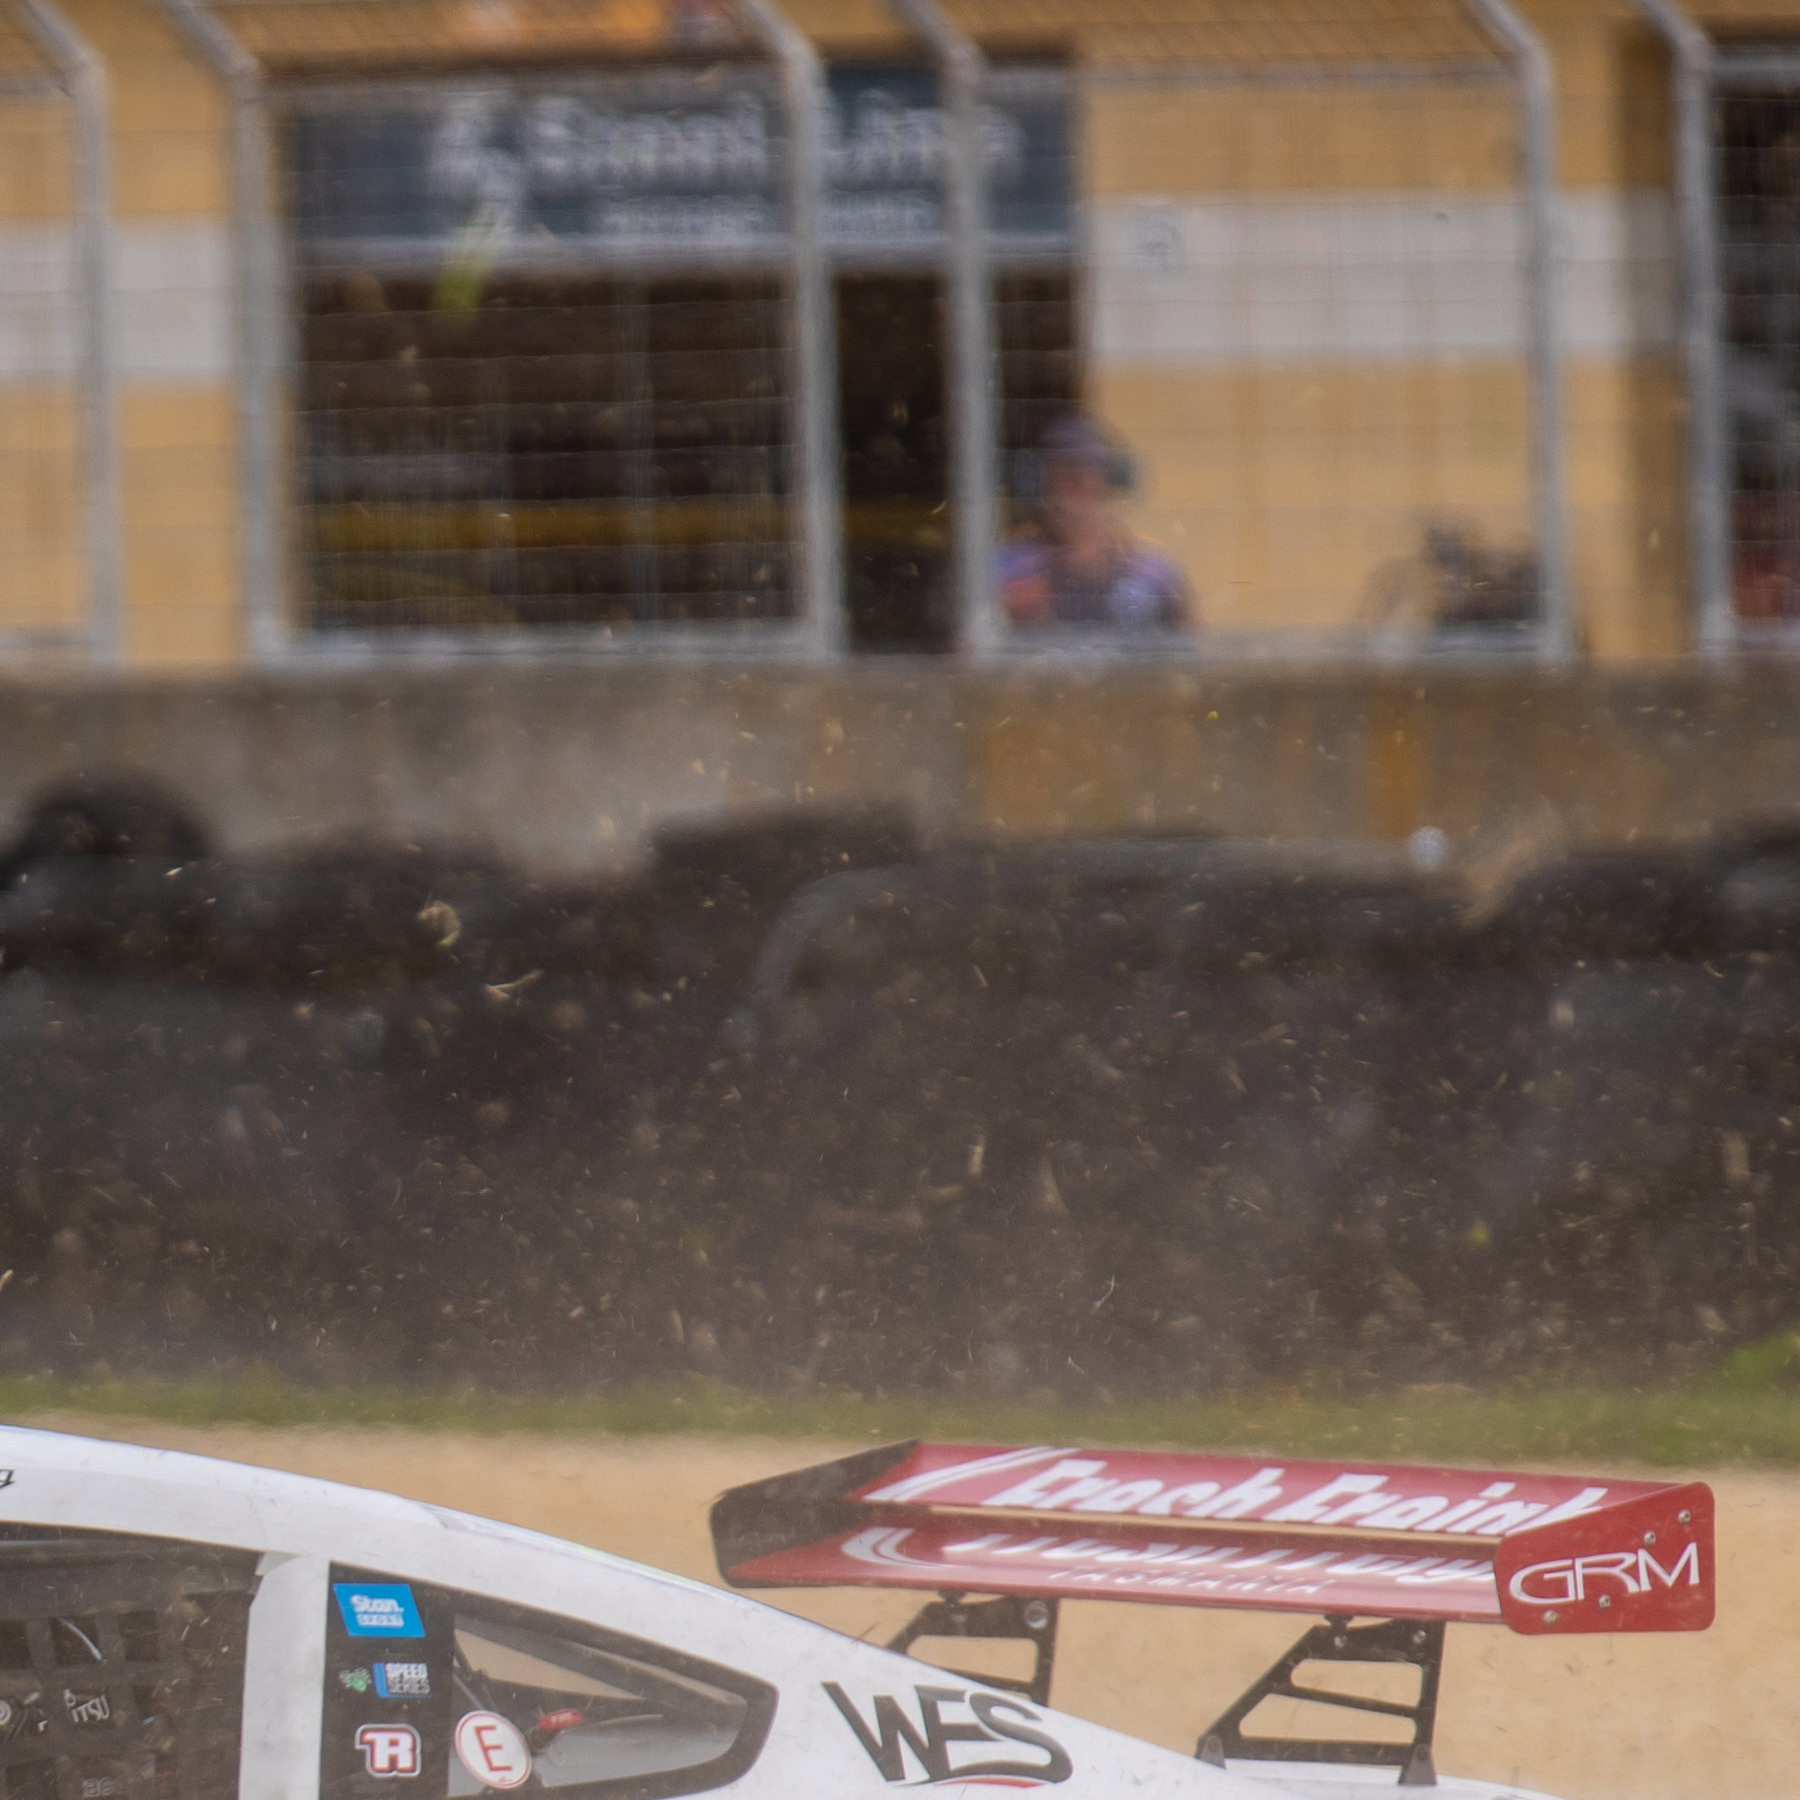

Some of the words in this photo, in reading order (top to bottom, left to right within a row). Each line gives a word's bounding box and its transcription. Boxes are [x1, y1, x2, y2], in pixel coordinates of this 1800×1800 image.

[1508, 1543, 1702, 1605] GRM
[473, 1724, 514, 1773] E
[822, 1680, 1075, 1786] WES
